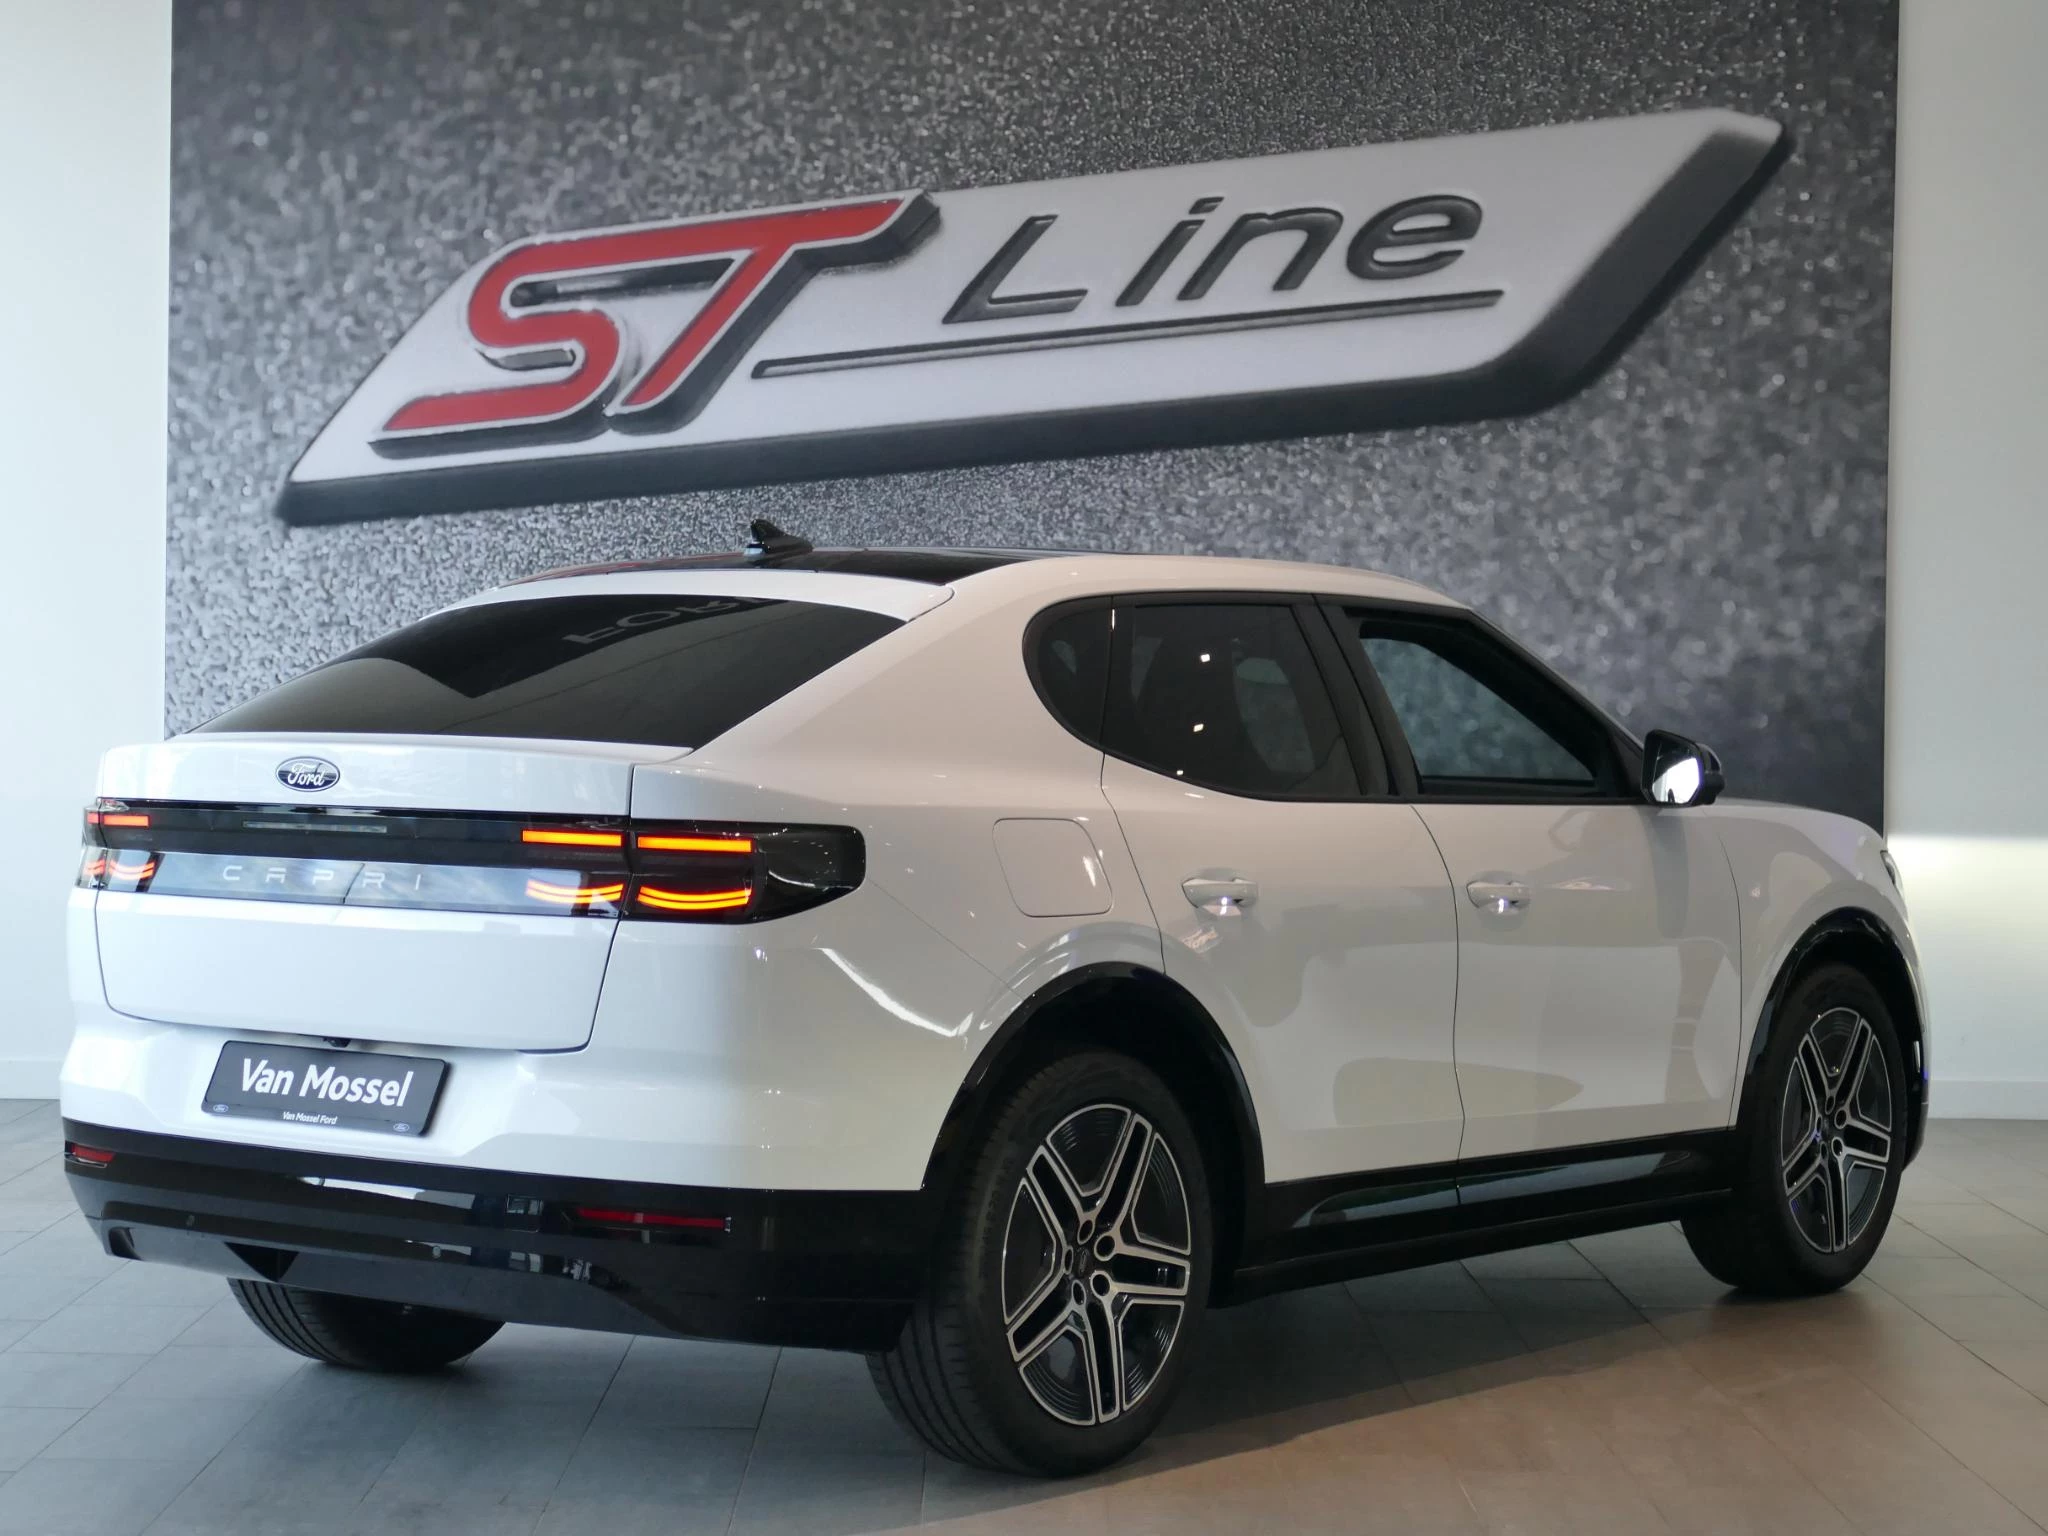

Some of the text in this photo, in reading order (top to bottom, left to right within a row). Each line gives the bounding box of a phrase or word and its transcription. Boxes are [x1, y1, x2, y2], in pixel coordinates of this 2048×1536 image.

[370, 192, 1483, 452] ST Line
[287, 762, 326, 786] Ford
[223, 865, 421, 890] CAPRI
[242, 1058, 414, 1107] Van Mossel
[283, 1111, 338, 1125] Van Mossel Ford
